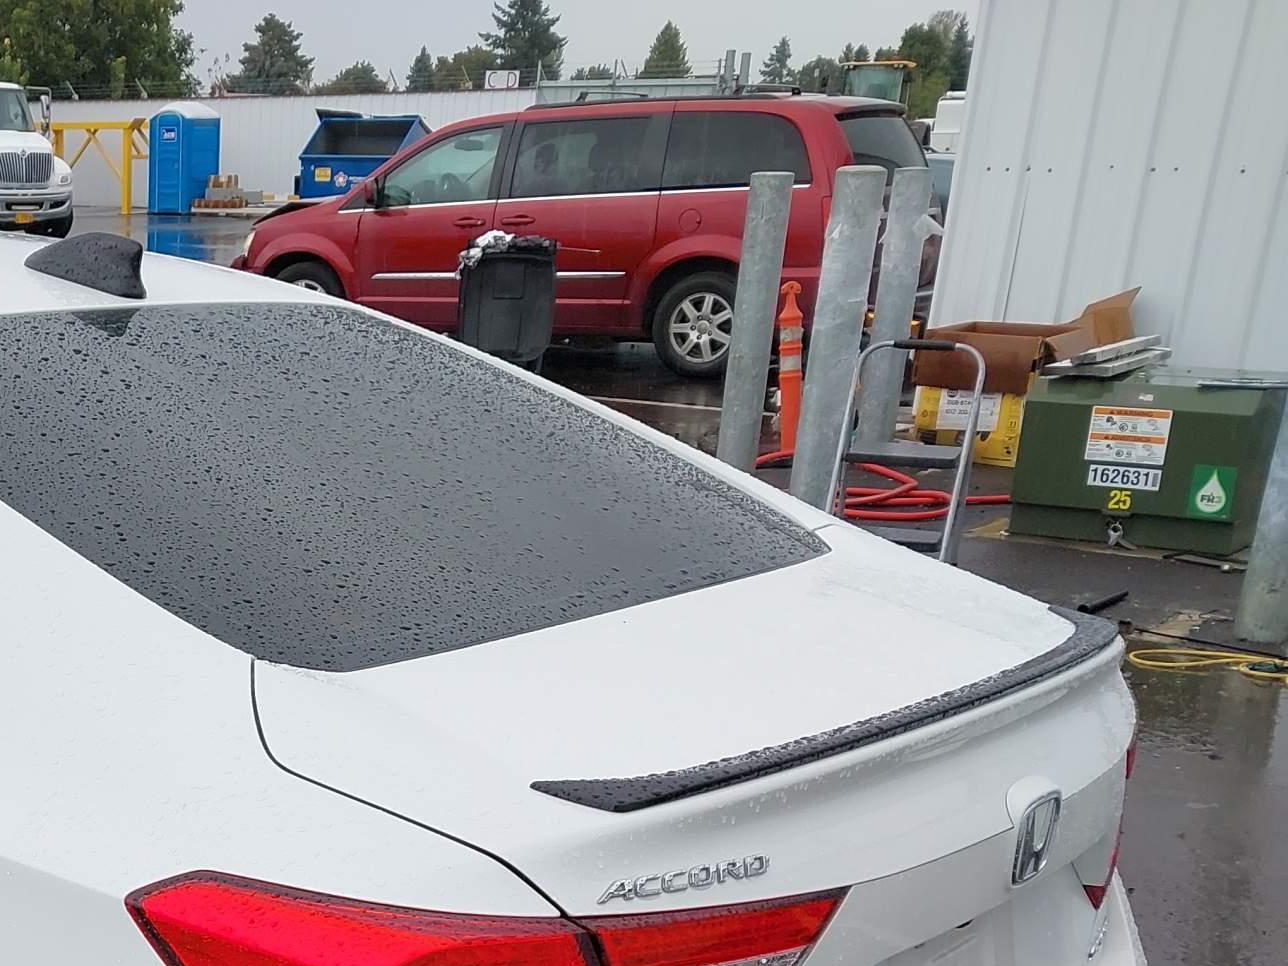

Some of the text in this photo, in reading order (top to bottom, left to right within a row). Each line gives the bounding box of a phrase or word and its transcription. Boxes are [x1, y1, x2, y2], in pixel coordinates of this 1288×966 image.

[487, 71, 517, 88] C D
[1091, 467, 1150, 487] 162631
[1108, 490, 1132, 509] 25
[596, 854, 770, 904] ACCORD
